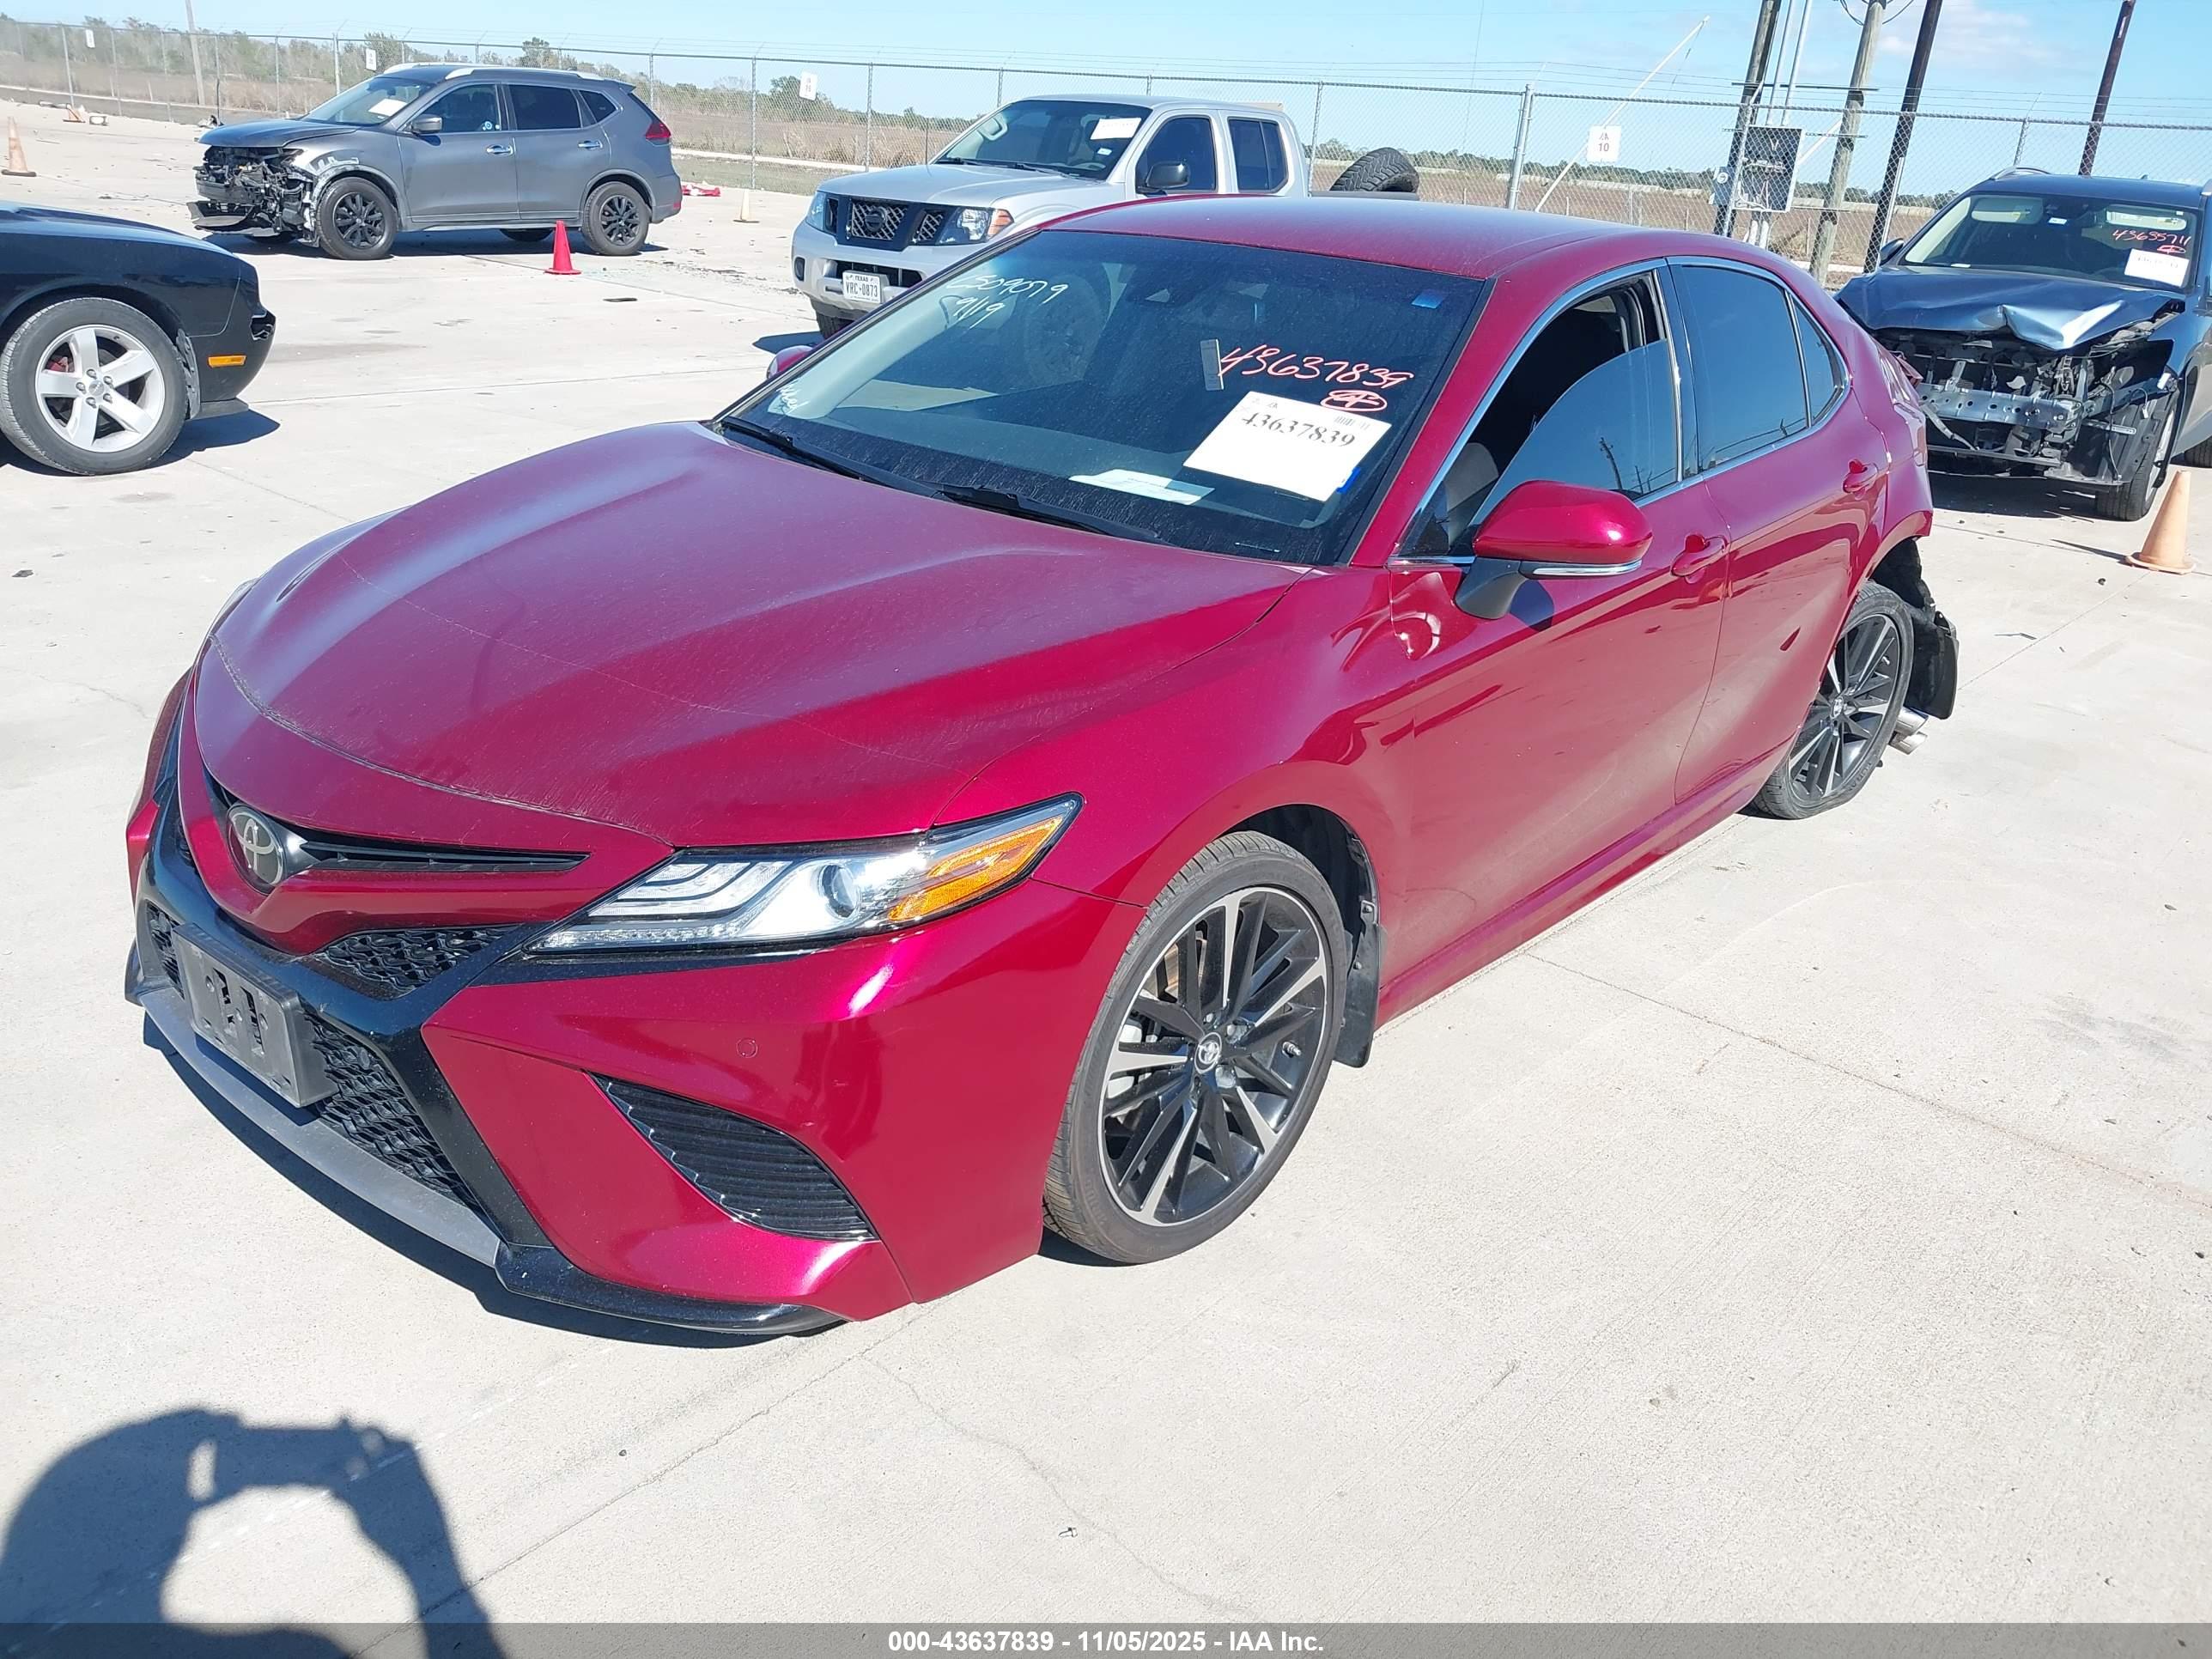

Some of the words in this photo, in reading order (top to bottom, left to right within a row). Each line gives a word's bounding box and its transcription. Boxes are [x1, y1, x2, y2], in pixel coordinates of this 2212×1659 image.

[1598, 143, 1610, 152] 10
[1217, 343, 1415, 389] 43637839
[1242, 411, 1357, 447] 43637839
